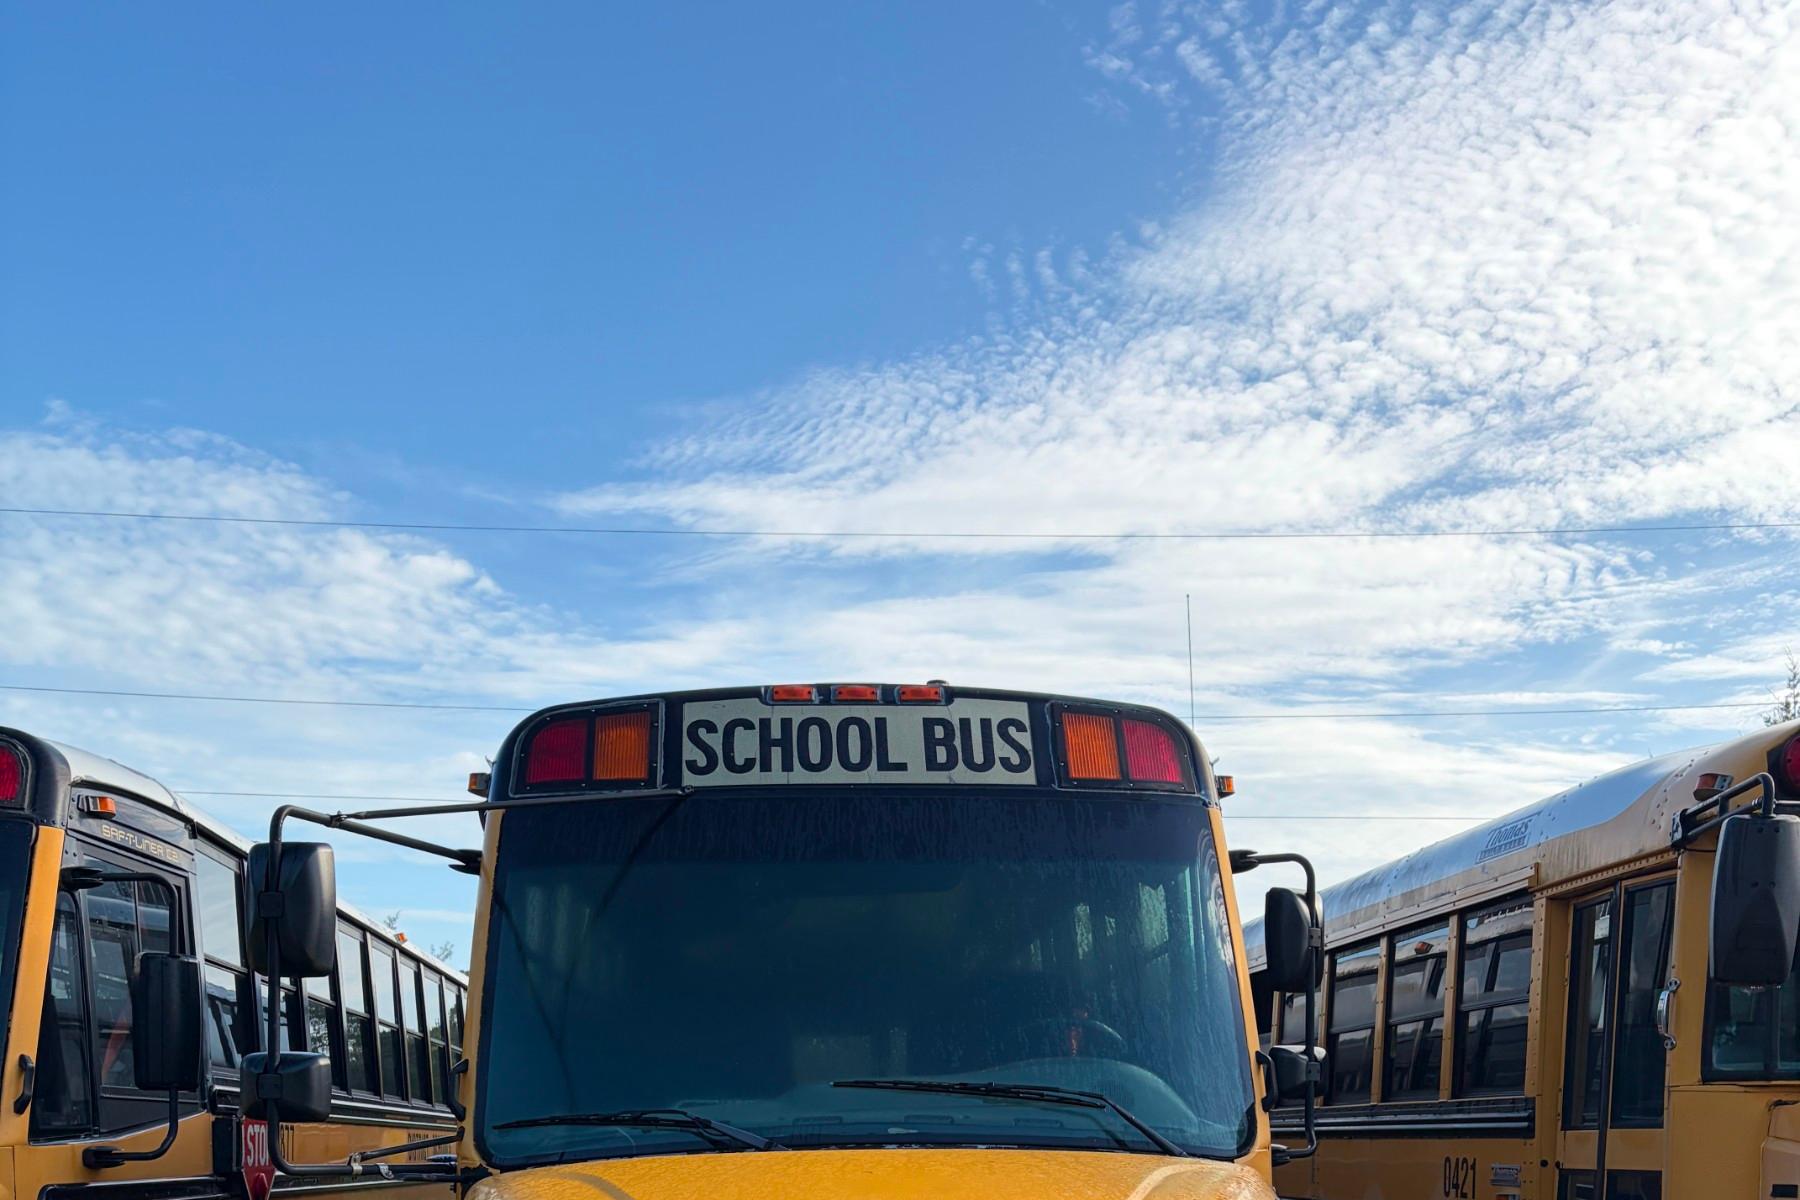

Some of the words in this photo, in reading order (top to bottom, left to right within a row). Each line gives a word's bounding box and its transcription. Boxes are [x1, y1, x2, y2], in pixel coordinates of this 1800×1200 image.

[684, 716, 908, 775] SCHOOL
[922, 716, 1032, 774] BUS
[1443, 1156, 1477, 1200] 0421
